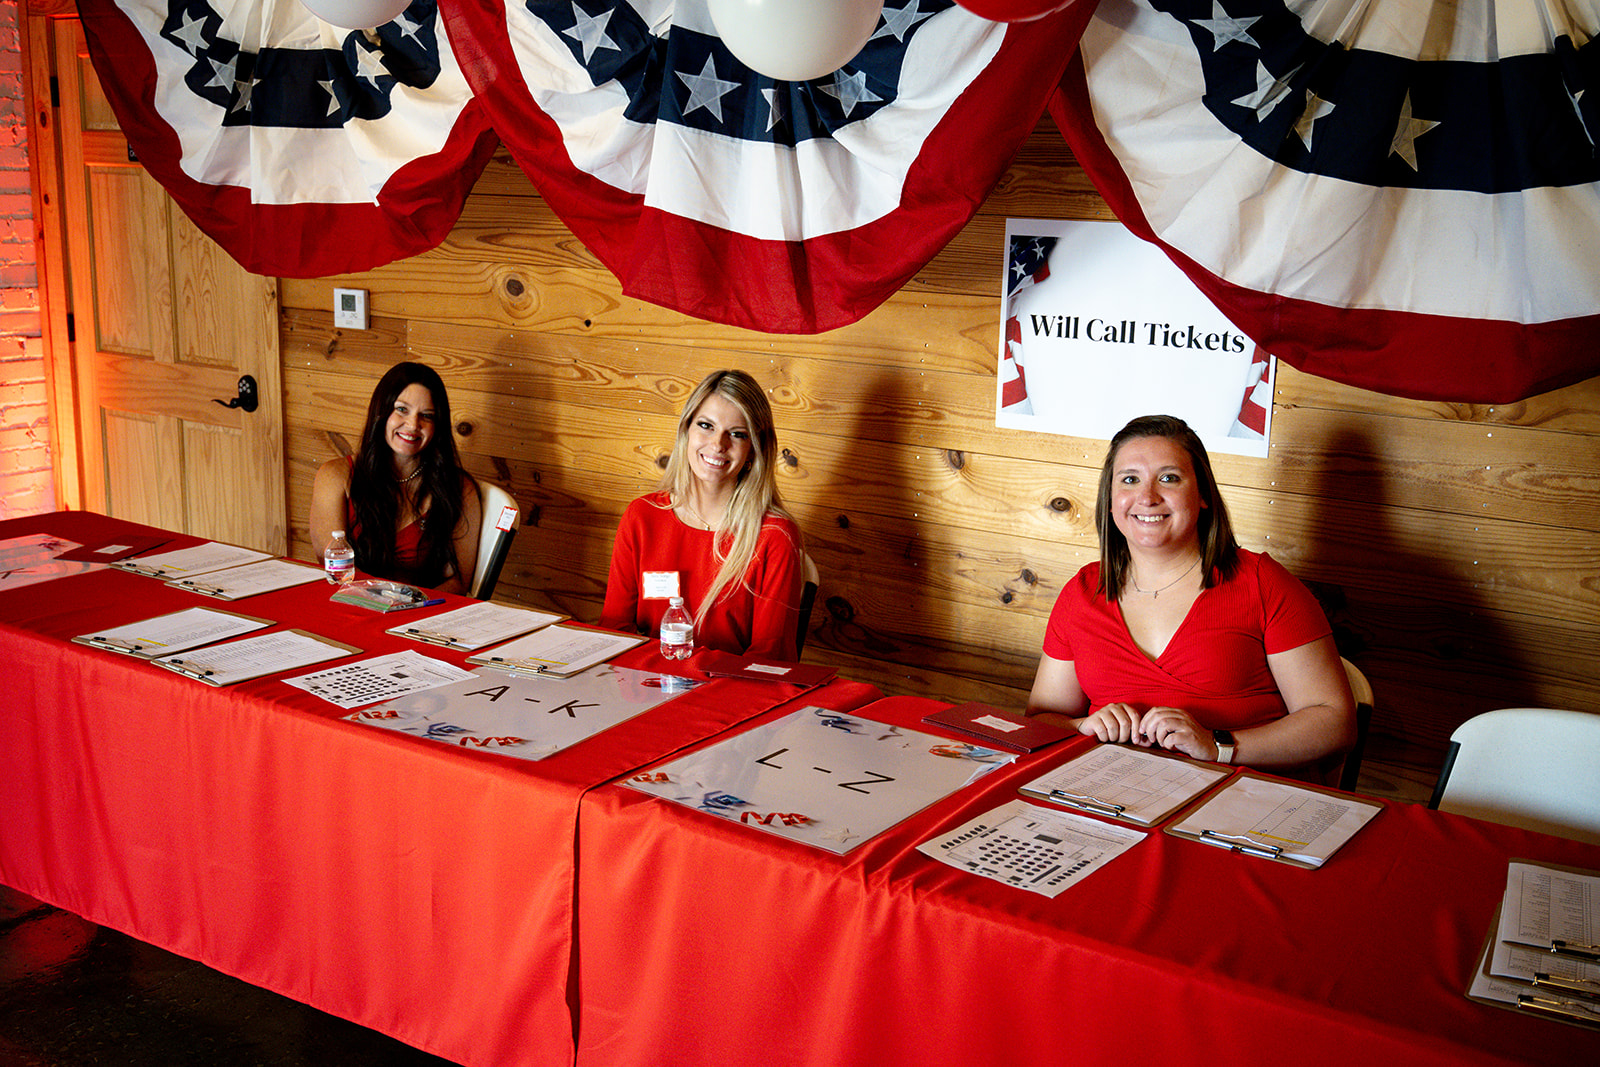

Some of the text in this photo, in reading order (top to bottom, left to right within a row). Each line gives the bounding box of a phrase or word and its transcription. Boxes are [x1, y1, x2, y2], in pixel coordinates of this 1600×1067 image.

[1030, 314, 1245, 353] Will Call Tickets
[463, 685, 511, 702] A
[547, 699, 601, 718] K
[755, 748, 896, 795] L - Z
